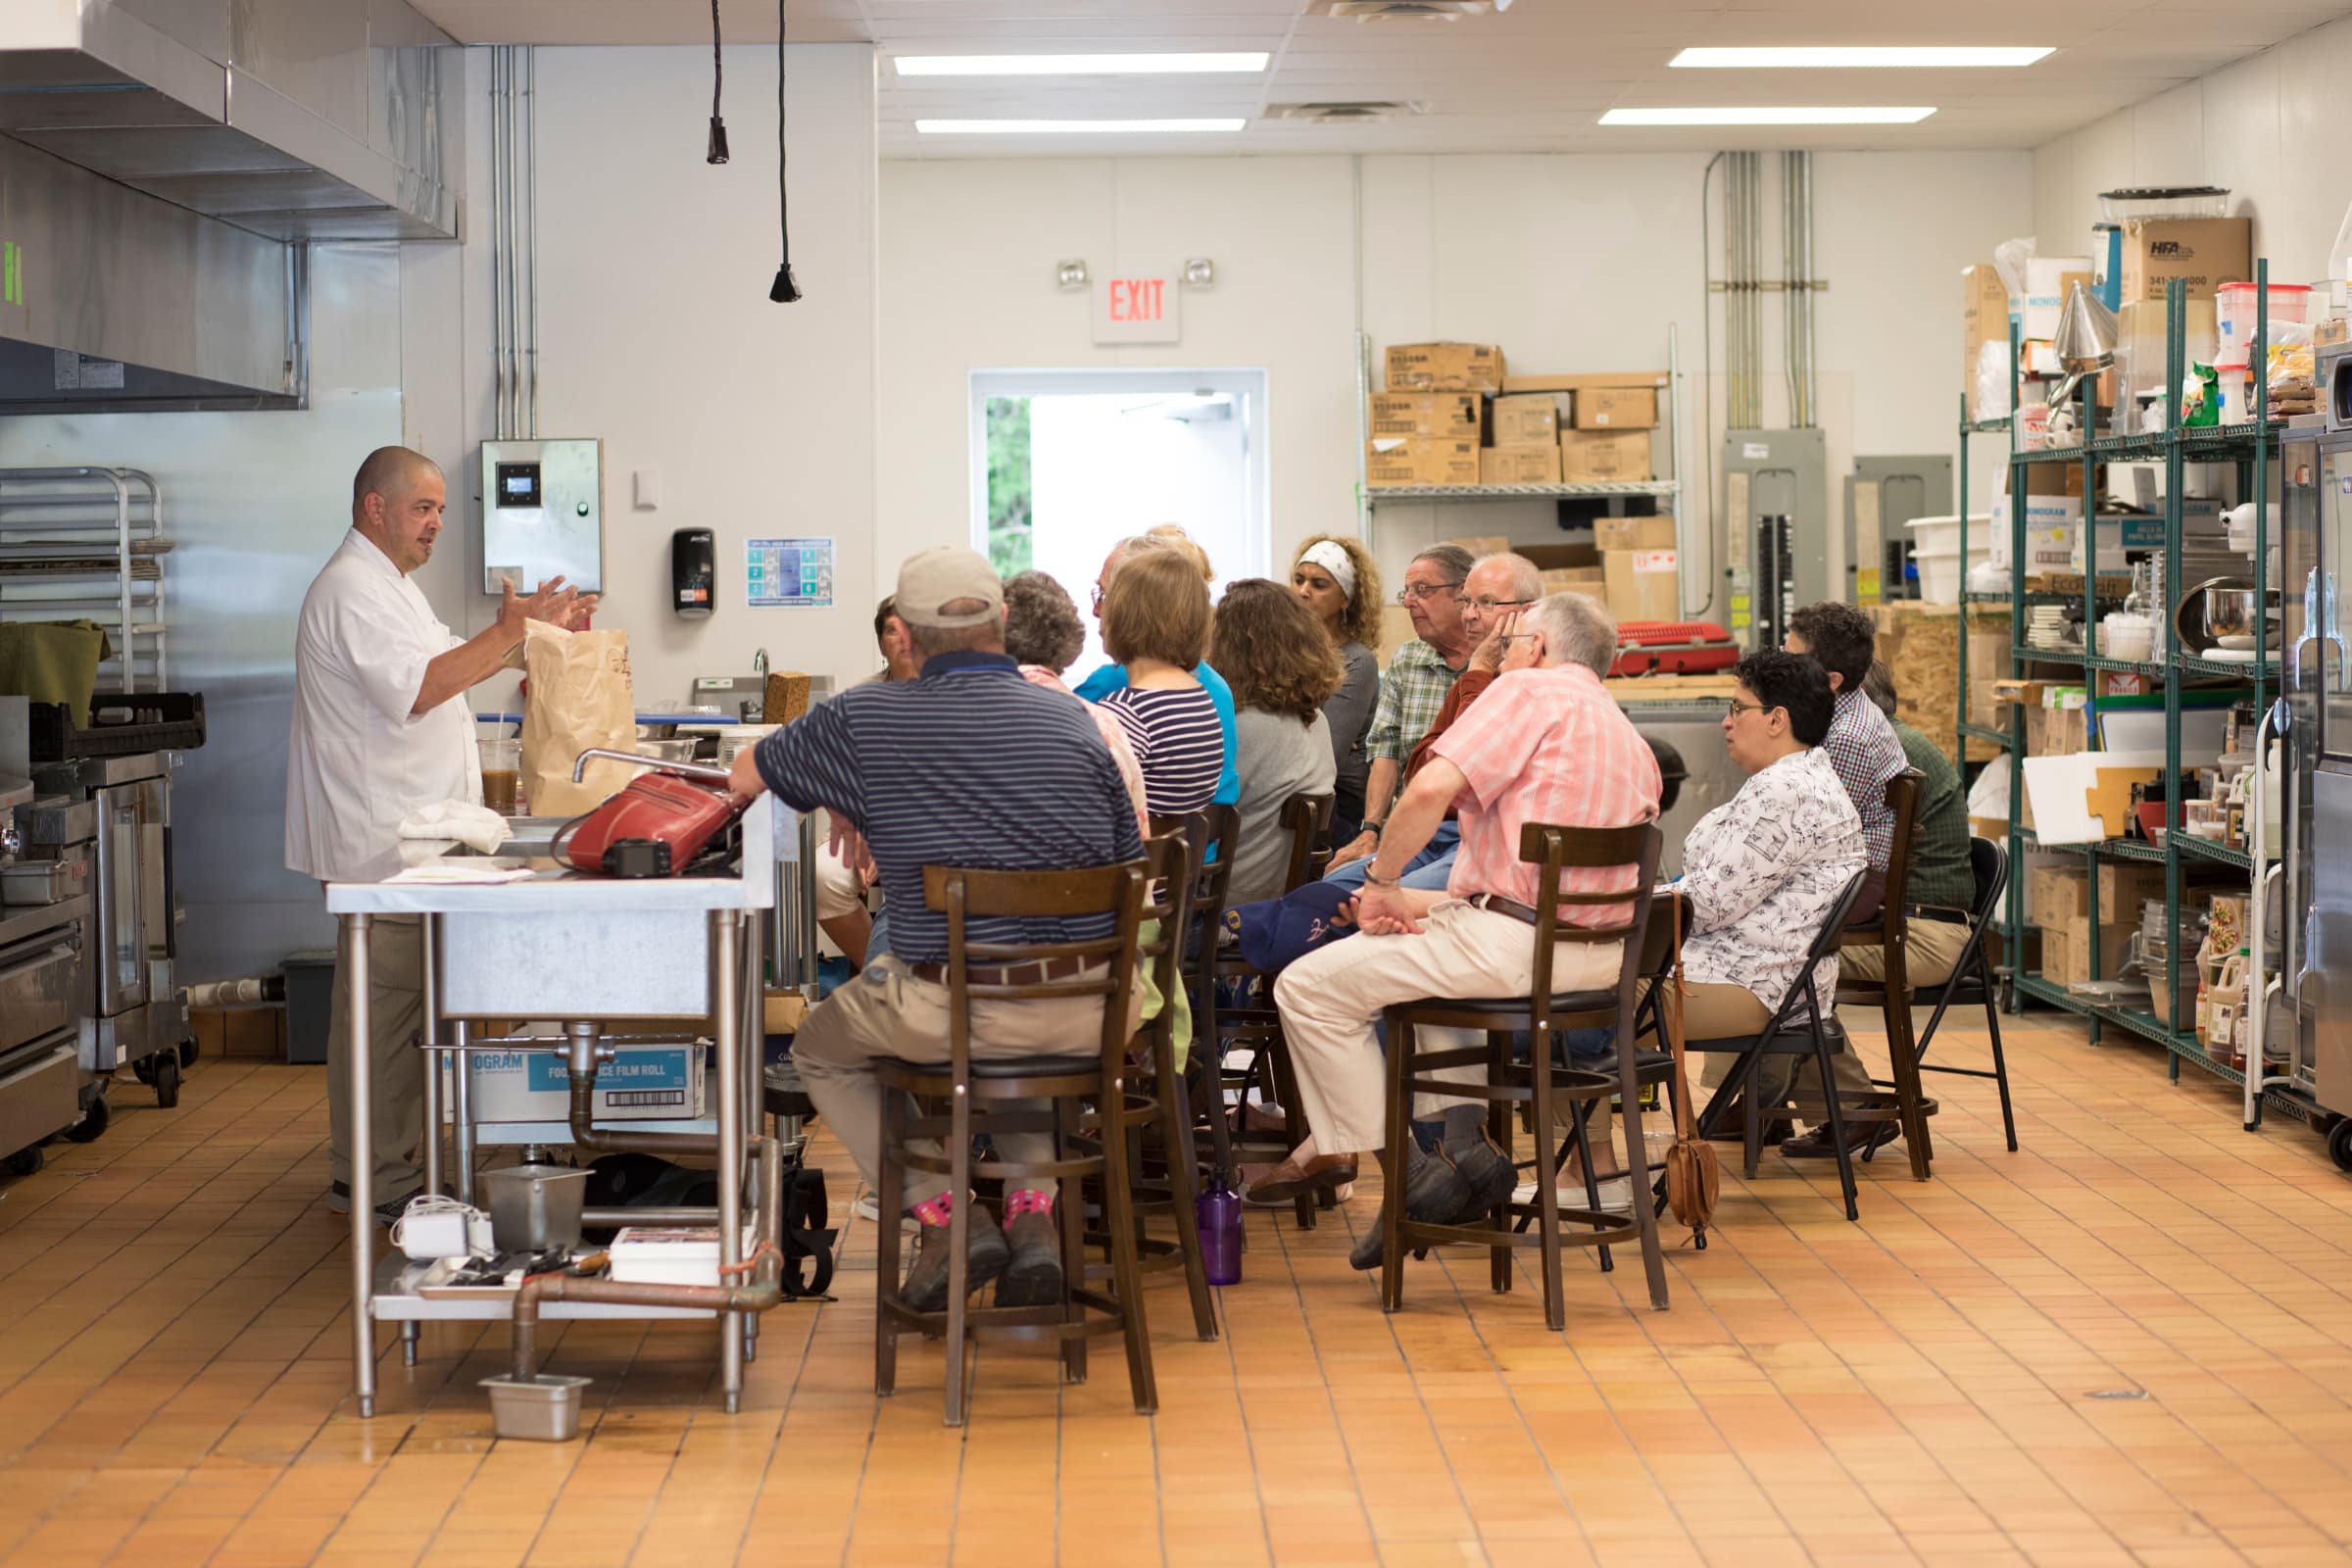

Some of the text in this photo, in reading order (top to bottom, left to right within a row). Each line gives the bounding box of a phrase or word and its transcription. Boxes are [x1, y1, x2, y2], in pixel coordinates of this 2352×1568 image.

[2150, 240, 2180, 254] HFA
[1109, 278, 1165, 321] EXIT
[616, 1065, 639, 1077] FILM
[641, 1064, 666, 1076] ROLL
